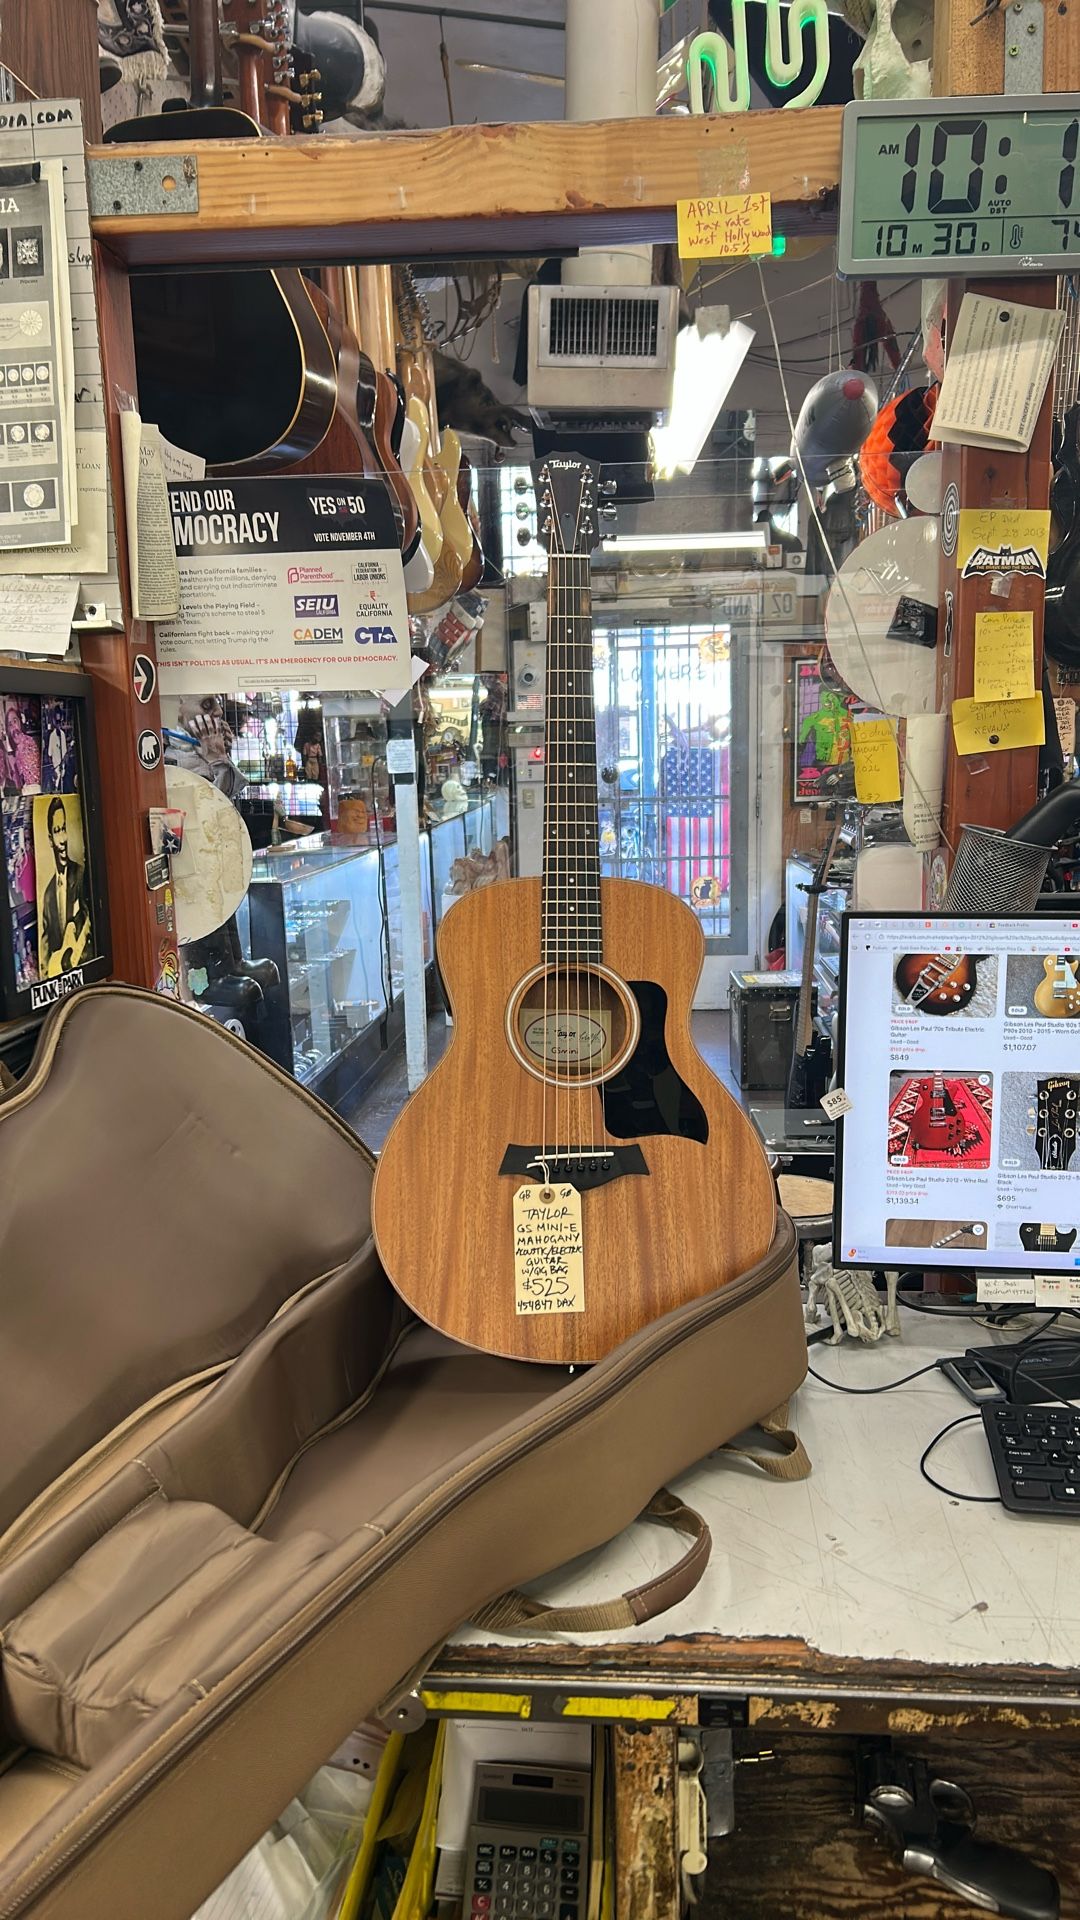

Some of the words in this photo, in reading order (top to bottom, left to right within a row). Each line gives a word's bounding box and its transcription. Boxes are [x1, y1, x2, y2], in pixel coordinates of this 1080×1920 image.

[878, 144, 900, 155] AM
[687, 201, 738, 218] APRIL
[741, 195, 768, 213] 1st
[988, 199, 1011, 207] AUTO
[696, 220, 720, 233] tax
[726, 214, 751, 227] rate
[876, 225, 907, 256] 10
[912, 244, 923, 253] M
[931, 223, 977, 255] 30
[982, 242, 990, 252] D
[720, 241, 750, 255] 10.5%
[549, 460, 582, 470] Taylor
[169, 491, 202, 512] END
[204, 489, 235, 511] OUR
[309, 497, 336, 515] YES
[336, 497, 346, 506] ON
[347, 496, 365, 513] 50
[313, 532, 330, 542] VOTE
[330, 532, 363, 542] NOVEMBER
[363, 531, 376, 541] 4TH
[971, 551, 1039, 567] BATMAN
[296, 598, 335, 611] SEIU
[198, 630, 214, 638] fight
[294, 628, 343, 640] CADEM
[355, 627, 398, 644] CTA
[554, 1029, 576, 1038] Tayor
[1003, 1044, 1037, 1052] $1,107.07
[1047, 1080, 1070, 1092] Gibson
[886, 1197, 919, 1205] $1,139.34
[522, 1206, 574, 1220] TAYLOR
[517, 1224, 532, 1233] GS
[537, 1223, 577, 1233] MINI-E
[517, 1233, 580, 1246] MAHOGANY
[550, 1265, 569, 1275] BAG
[523, 1277, 570, 1297] $525
[517, 1299, 553, 1312] 454847
[505, 1864, 511, 1874] 7
[524, 1866, 530, 1875] 8
[544, 1867, 551, 1877] 9
[503, 1881, 509, 1891] 4
[523, 1882, 530, 1893] 5
[543, 1884, 550, 1894] 6
[477, 1896, 485, 1906] C
[502, 1898, 507, 1909] 1
[522, 1901, 529, 1911] 2
[543, 1902, 549, 1913] 3
